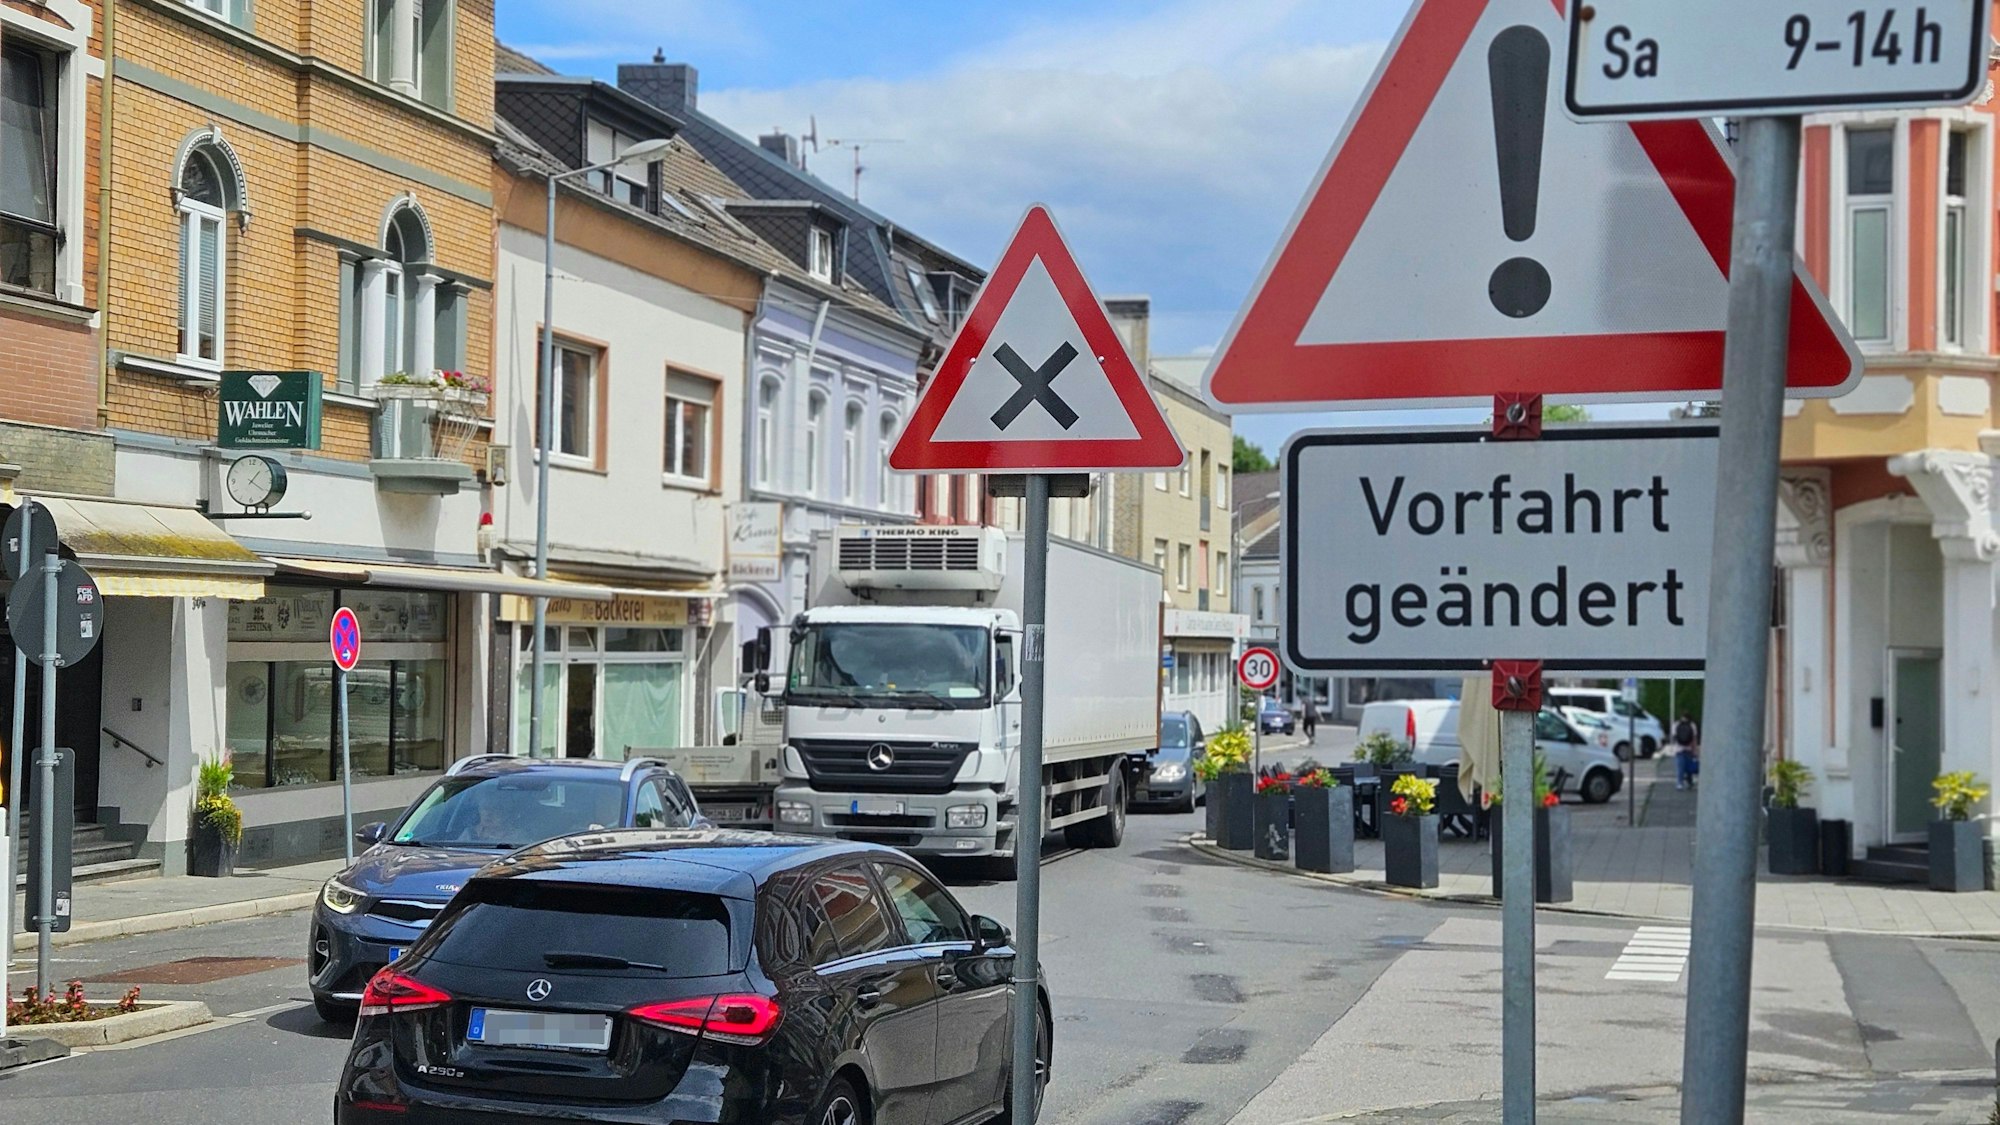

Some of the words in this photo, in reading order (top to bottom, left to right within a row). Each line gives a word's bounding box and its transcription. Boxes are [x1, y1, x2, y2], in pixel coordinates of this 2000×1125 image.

[1602, 25, 1659, 80] Sa
[223, 400, 304, 428] WAHLEN
[1359, 473, 1670, 536] Vorfahrt
[77, 587, 93, 595] FCK
[1345, 566, 1684, 645] geändert
[1248, 659, 1271, 678] 30
